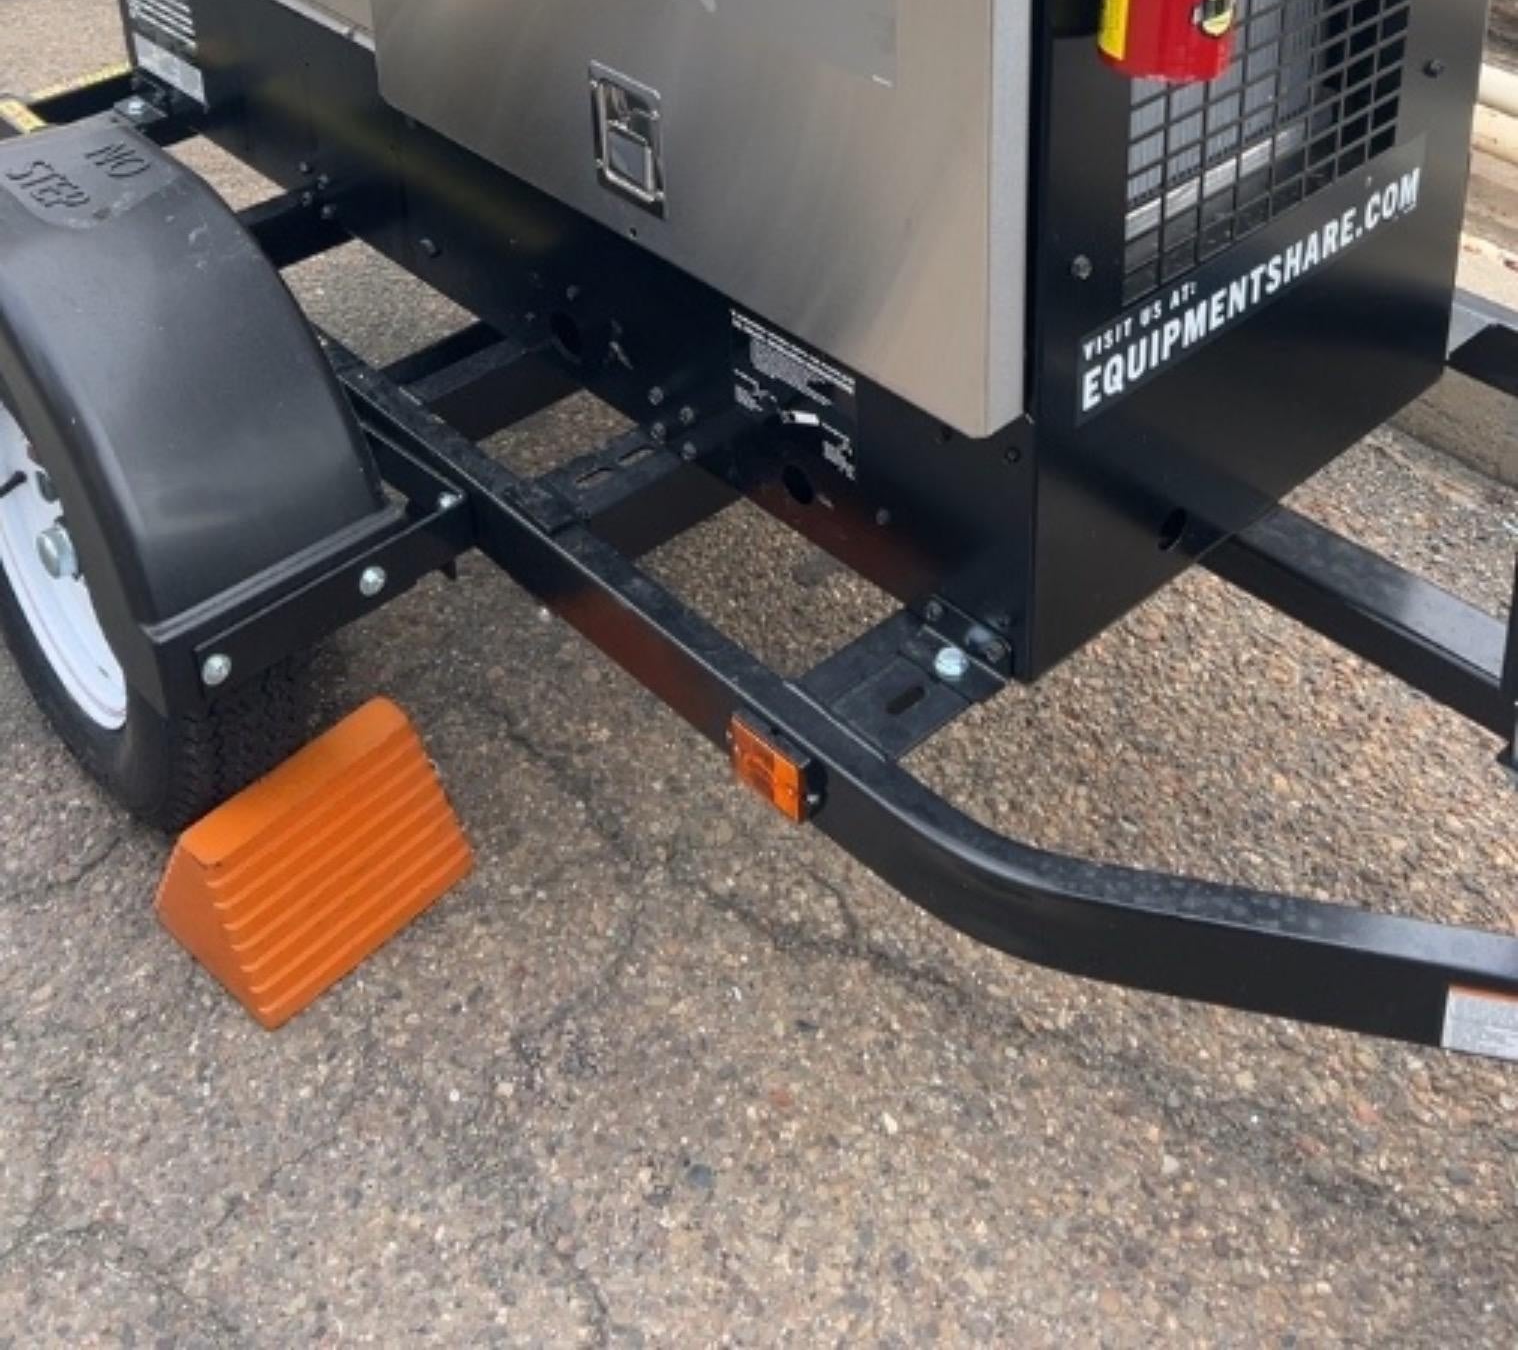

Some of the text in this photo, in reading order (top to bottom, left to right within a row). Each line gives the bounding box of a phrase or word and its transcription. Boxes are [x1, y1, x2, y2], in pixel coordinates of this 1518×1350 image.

[1081, 167, 1421, 412] EQUIPMENTSHARE.COM
[1082, 317, 1132, 361] VISIT
[1139, 300, 1162, 327] US
